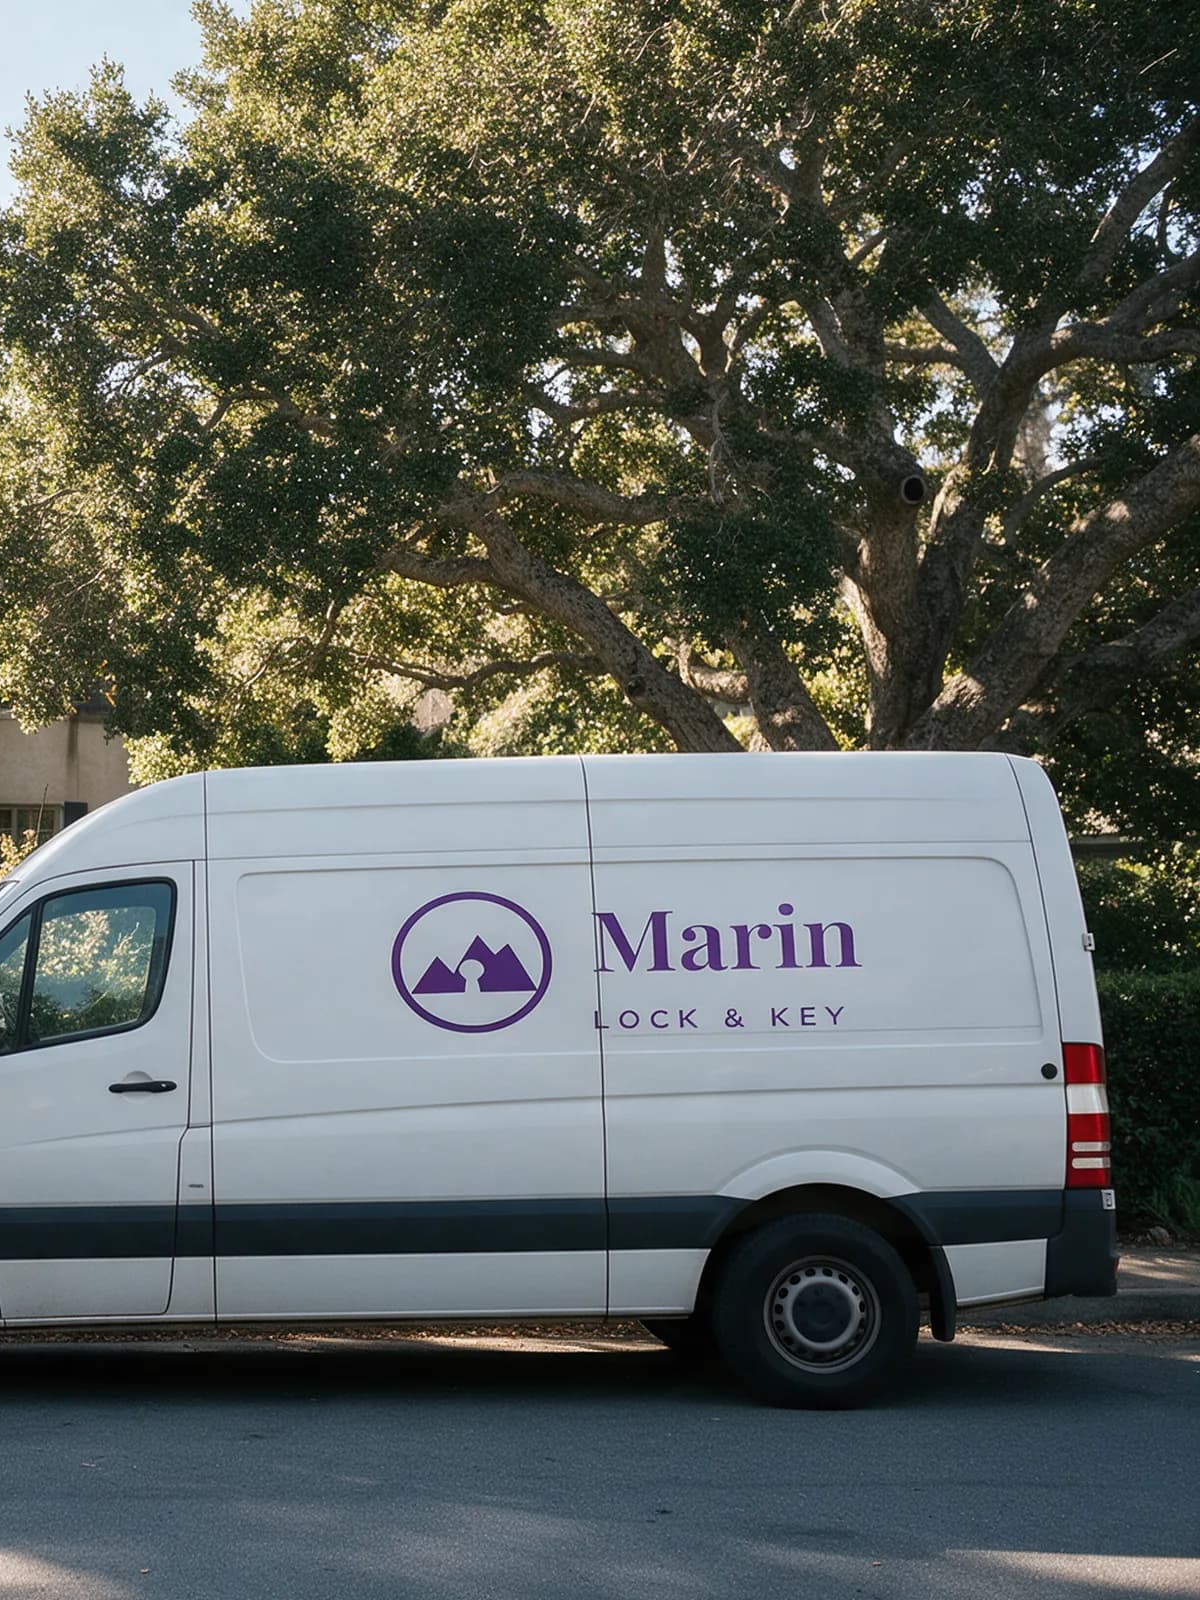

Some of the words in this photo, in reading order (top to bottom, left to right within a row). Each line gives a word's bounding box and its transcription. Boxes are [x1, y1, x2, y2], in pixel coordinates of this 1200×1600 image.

[592, 903, 863, 972] Marin
[594, 1008, 699, 1029] LOCK
[725, 1008, 745, 1028] &
[771, 1006, 845, 1027] KEY
